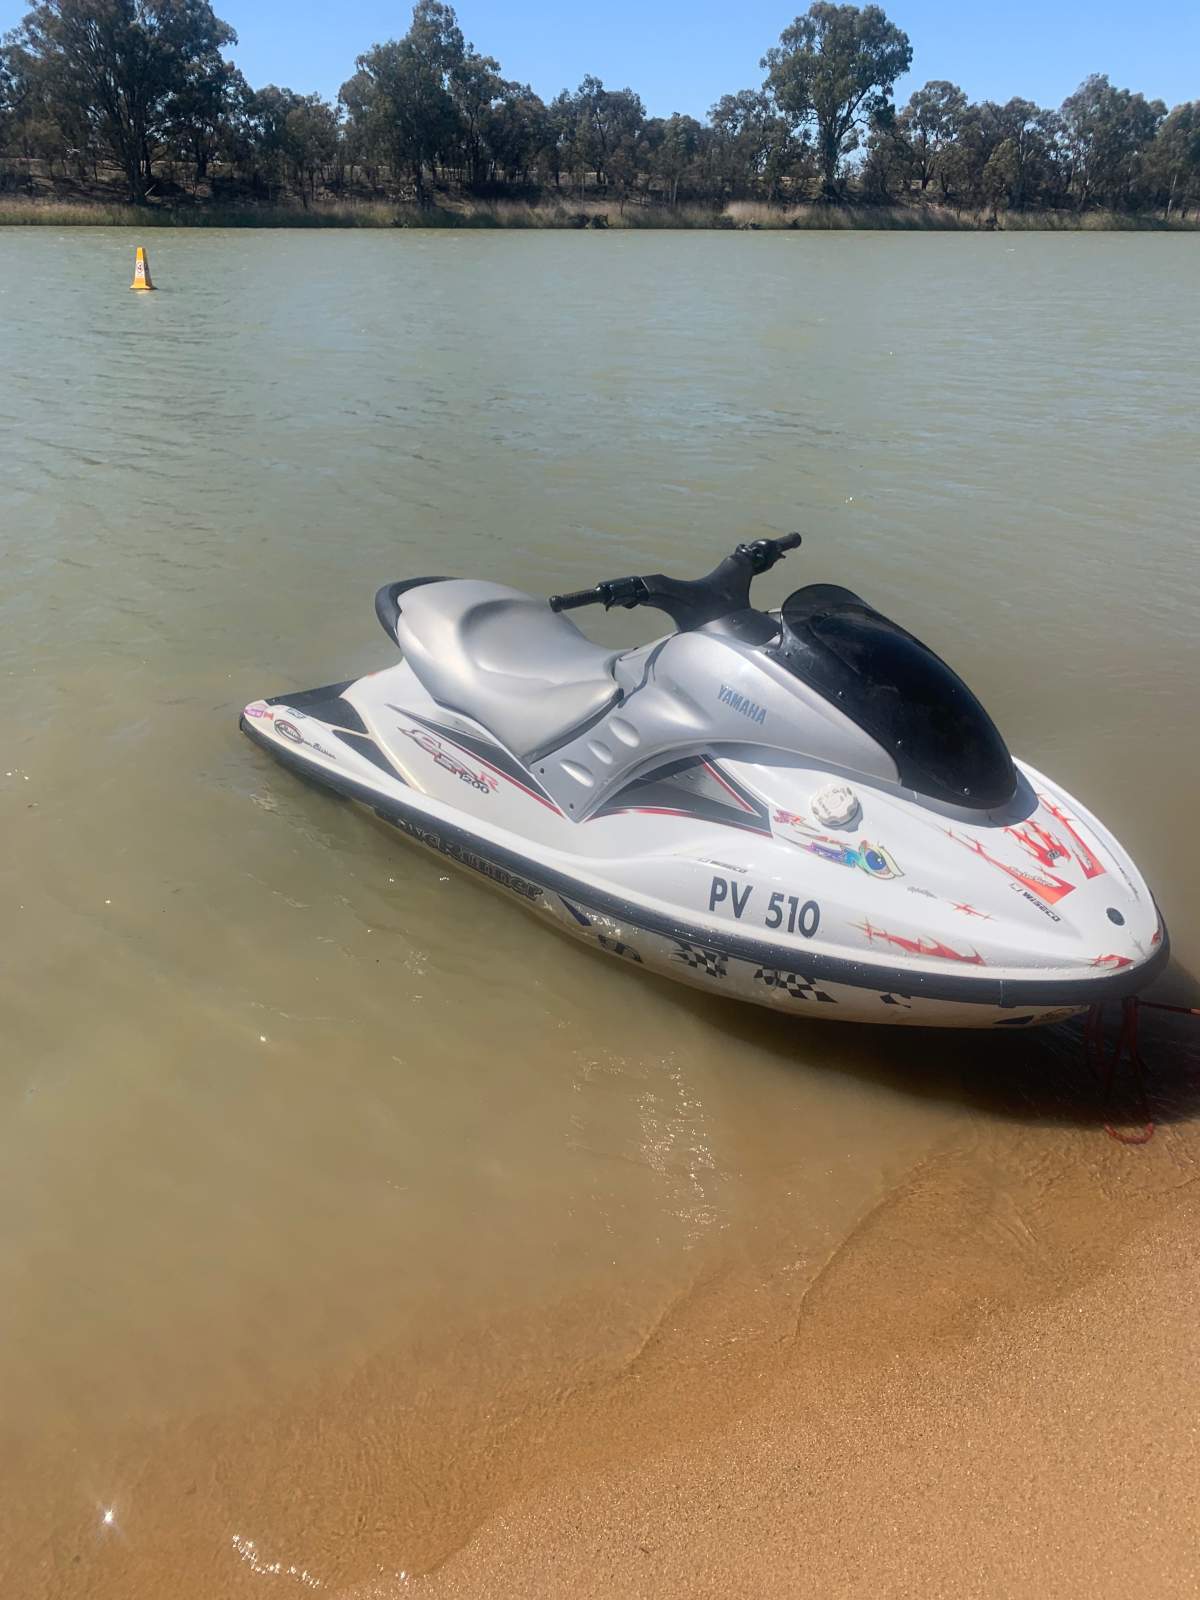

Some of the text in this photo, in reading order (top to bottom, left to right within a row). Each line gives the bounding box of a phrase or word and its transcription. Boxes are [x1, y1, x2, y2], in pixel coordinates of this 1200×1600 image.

[718, 684, 767, 725] YAMAHA
[460, 772, 489, 794] 1200
[709, 876, 820, 939] PV 510
